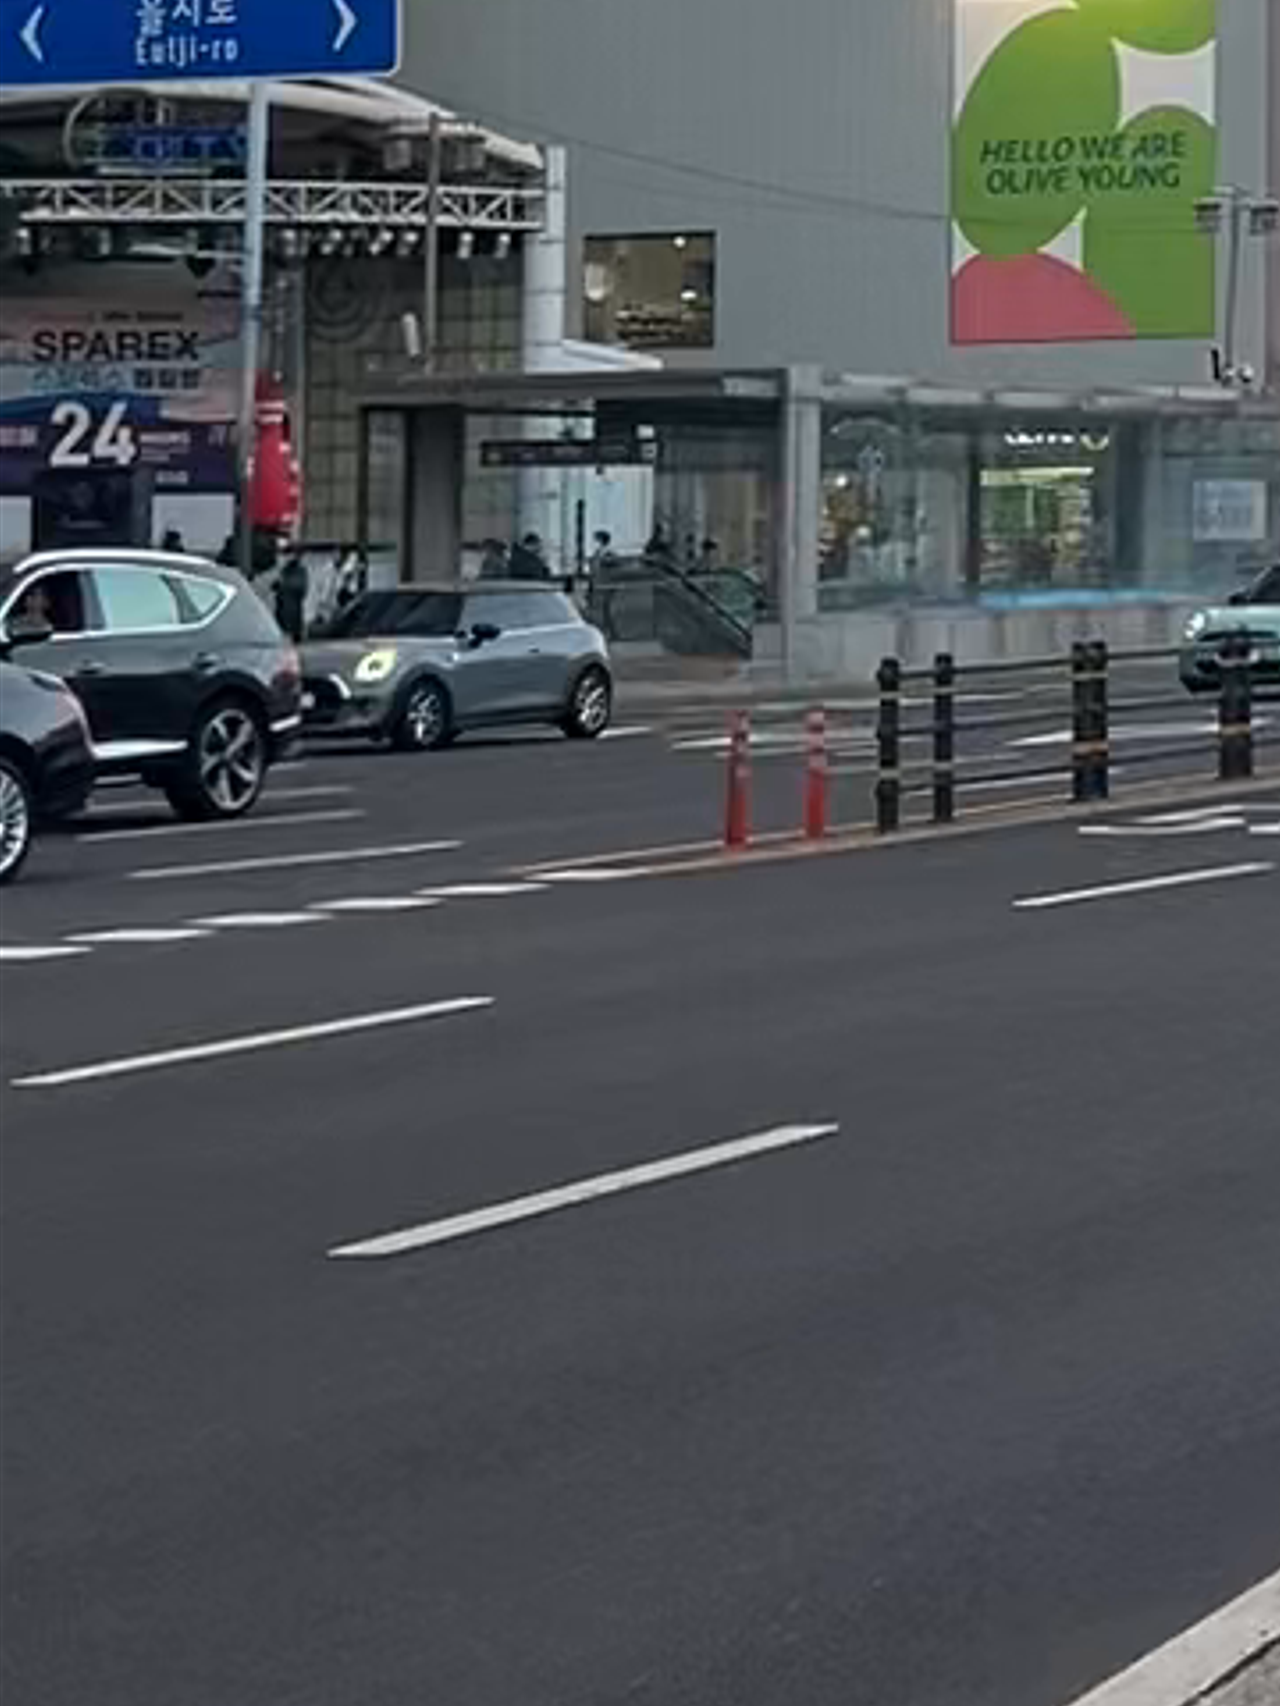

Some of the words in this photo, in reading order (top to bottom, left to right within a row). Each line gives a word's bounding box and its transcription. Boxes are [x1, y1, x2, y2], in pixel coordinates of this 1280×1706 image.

[135, 36, 239, 68] Eulji-ro
[980, 136, 1075, 165] HELLO
[1079, 133, 1126, 160] WE
[1132, 129, 1187, 159] ARE
[985, 165, 1071, 195] OLIVE
[1076, 161, 1181, 191] YOUNG
[32, 330, 200, 361] SPAREX
[49, 399, 137, 467] 24
